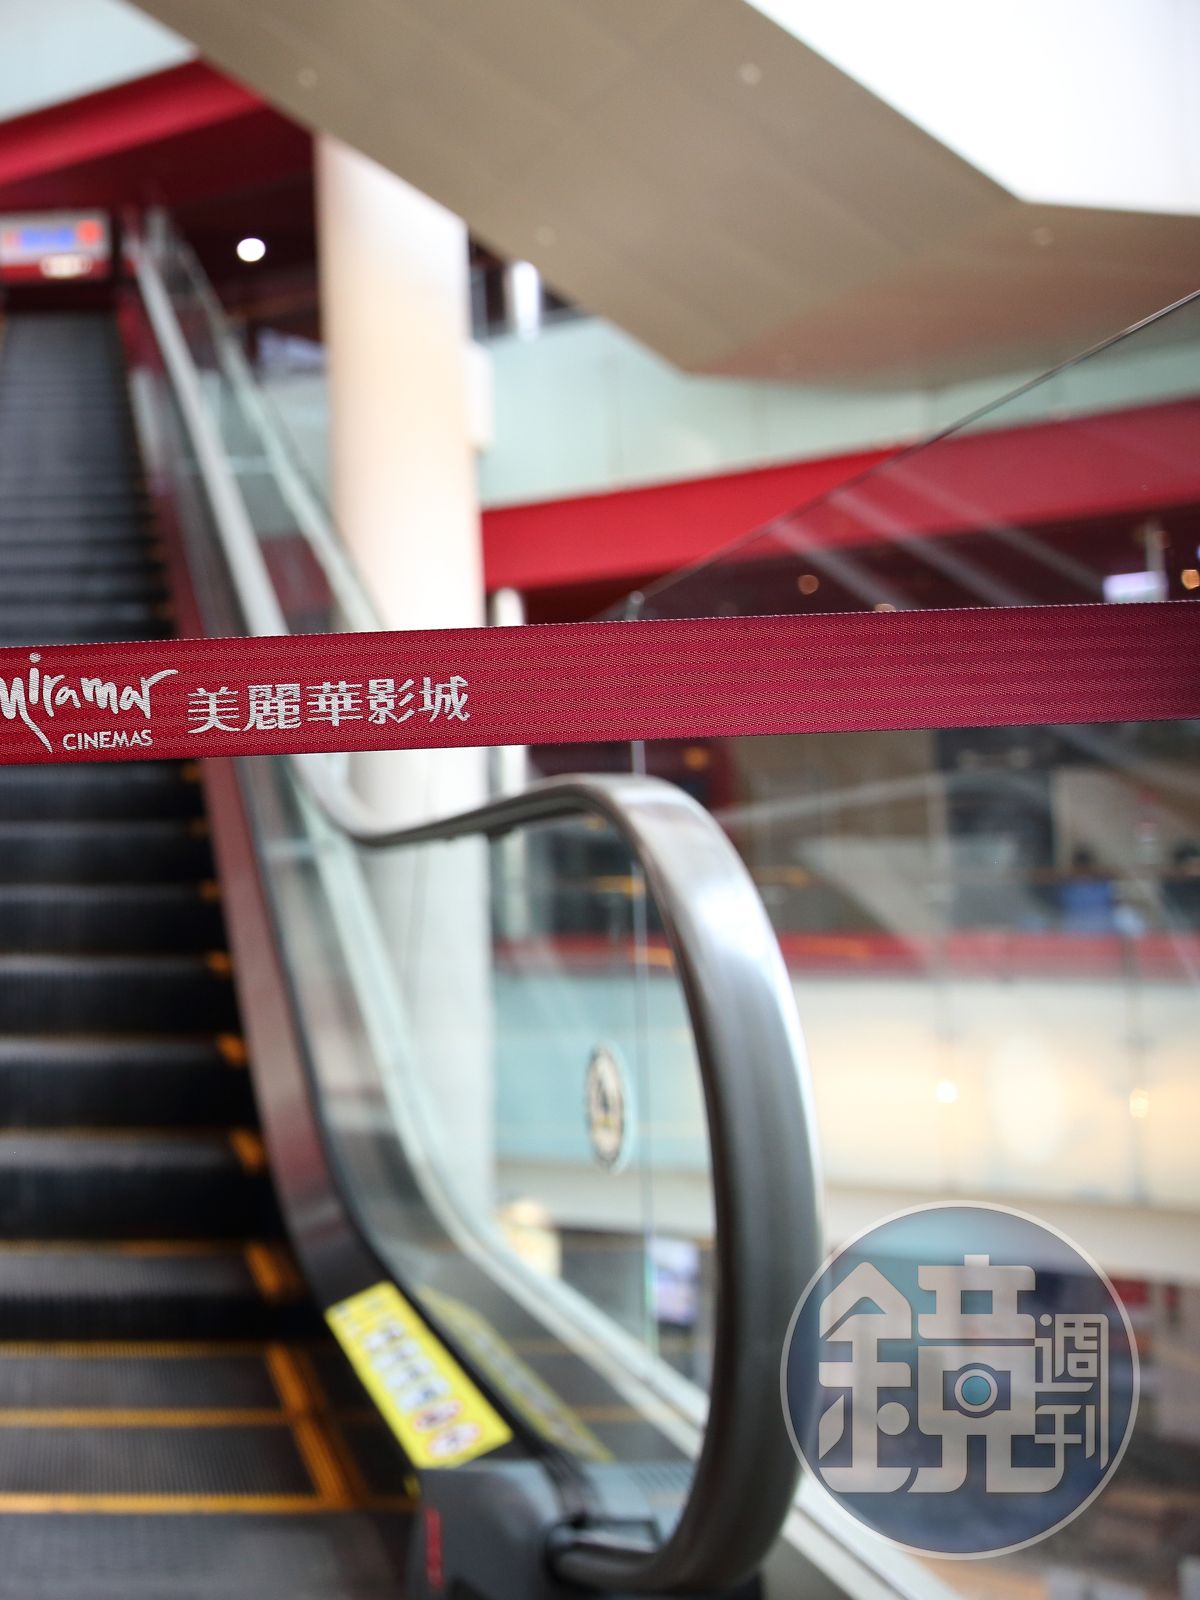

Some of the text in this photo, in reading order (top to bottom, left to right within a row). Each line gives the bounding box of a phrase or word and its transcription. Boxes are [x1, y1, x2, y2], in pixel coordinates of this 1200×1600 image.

[187, 675, 470, 734] 美麗華影城
[62, 729, 154, 751] CINEMAS
